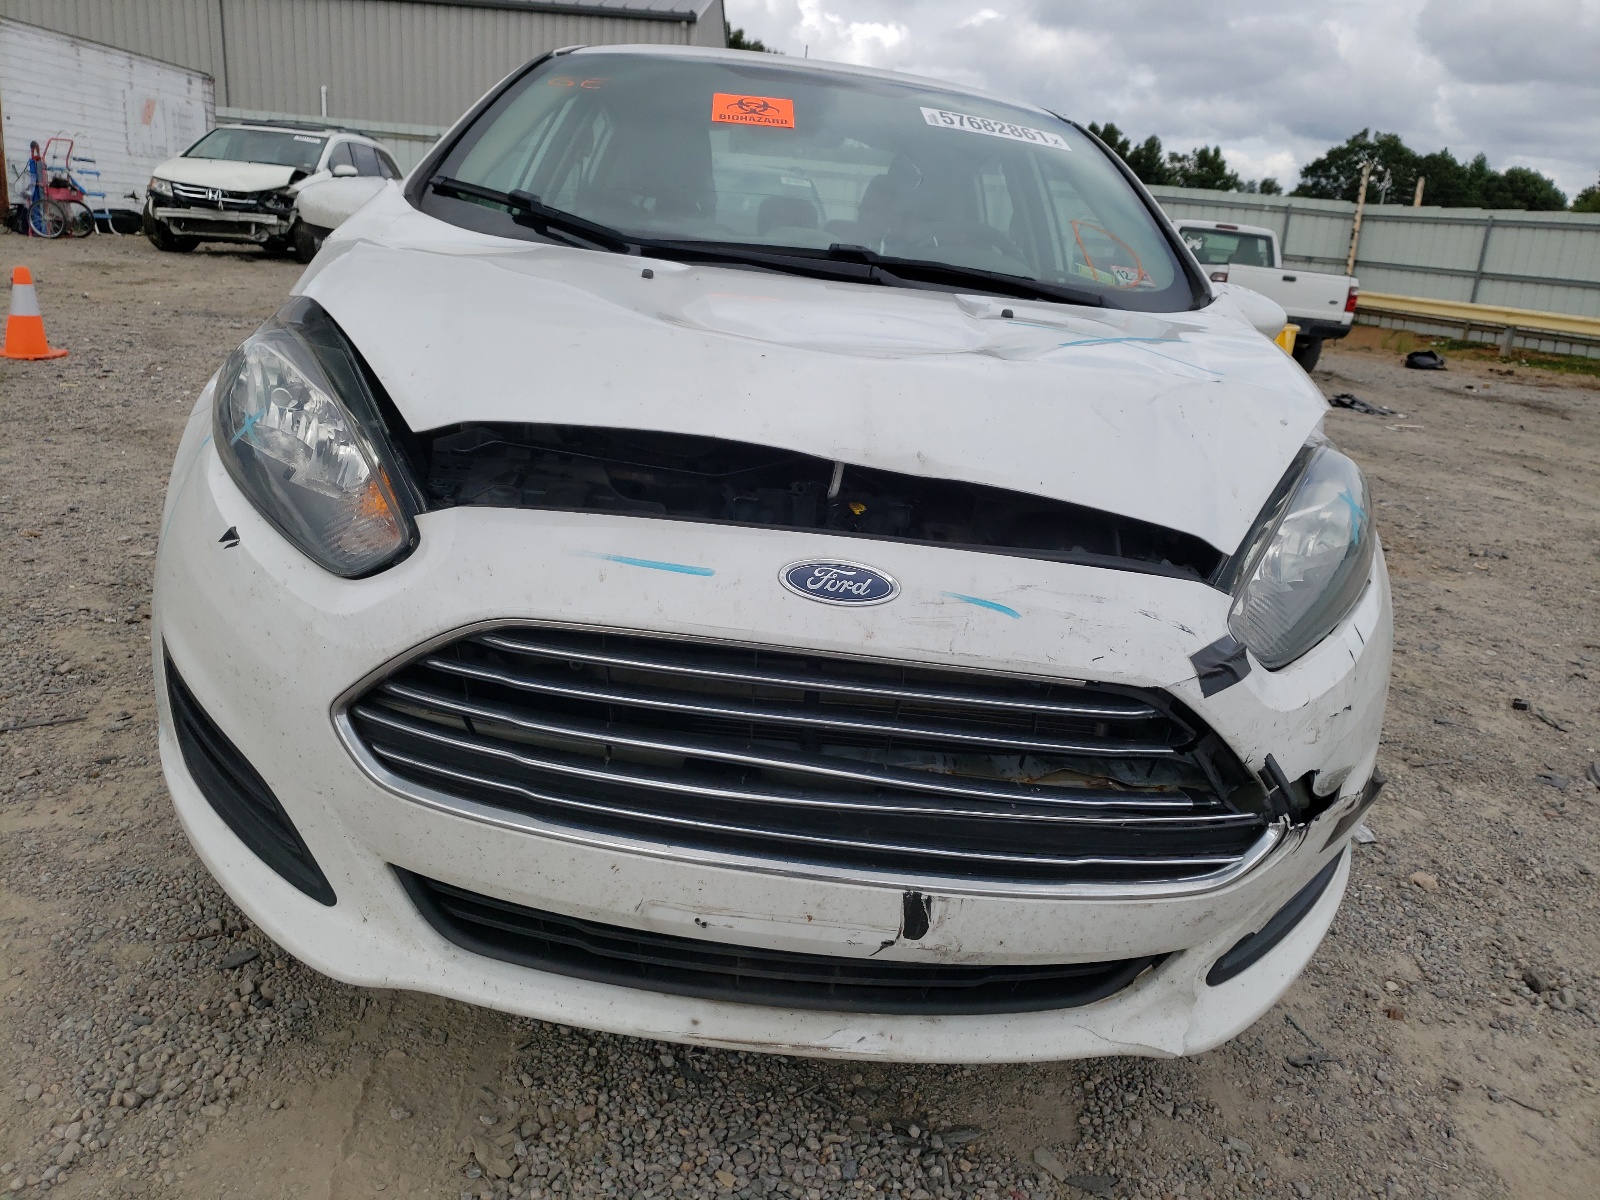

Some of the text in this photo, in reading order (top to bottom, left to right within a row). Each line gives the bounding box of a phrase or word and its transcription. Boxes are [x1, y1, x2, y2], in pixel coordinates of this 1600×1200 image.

[719, 113, 788, 125] BIOHAZARD
[939, 111, 1049, 143] 57682861
[806, 567, 873, 596] Ford
